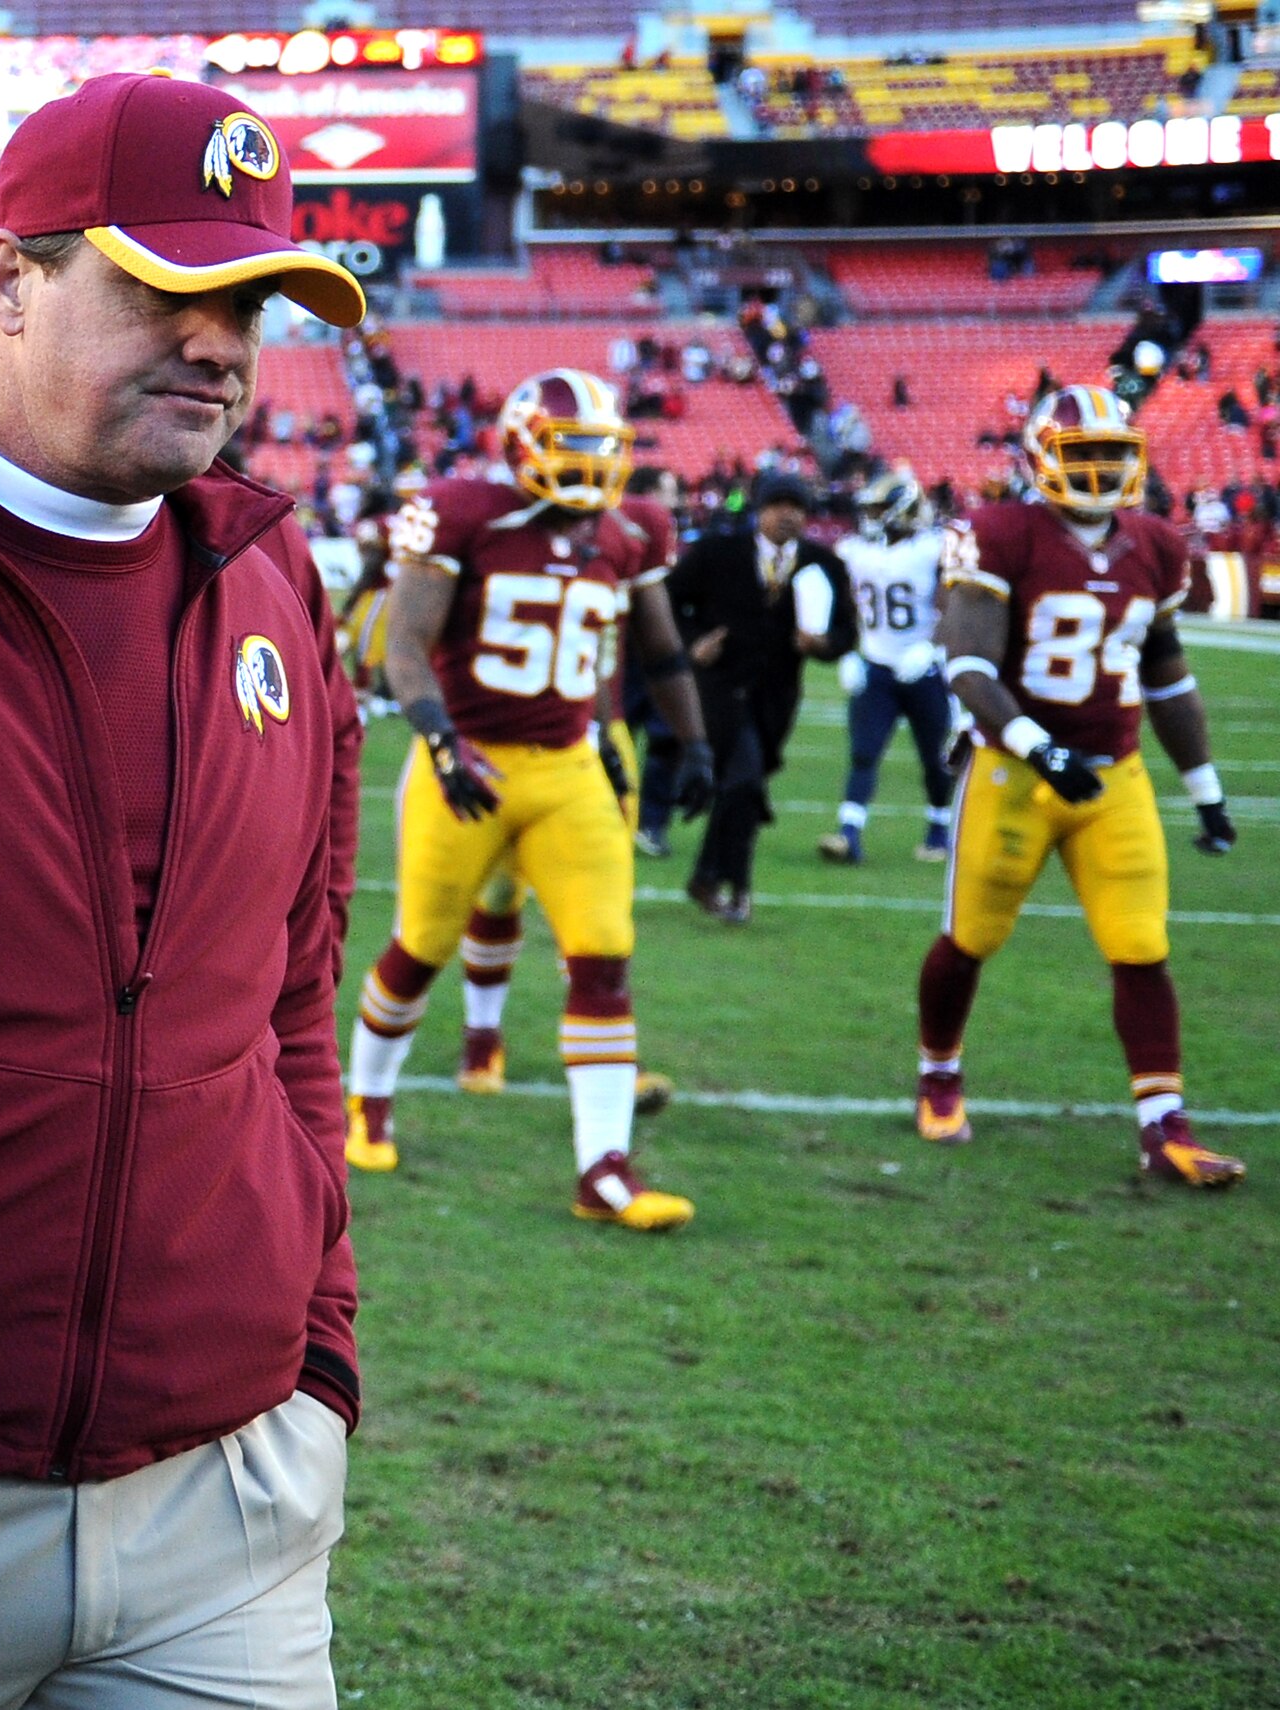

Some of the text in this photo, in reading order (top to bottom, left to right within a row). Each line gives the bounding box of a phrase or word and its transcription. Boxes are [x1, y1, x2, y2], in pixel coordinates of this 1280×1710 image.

[991, 115, 1242, 173] WELCOME
[291, 188, 409, 246] oke
[472, 572, 618, 700] 56
[1020, 590, 1156, 708] 84
